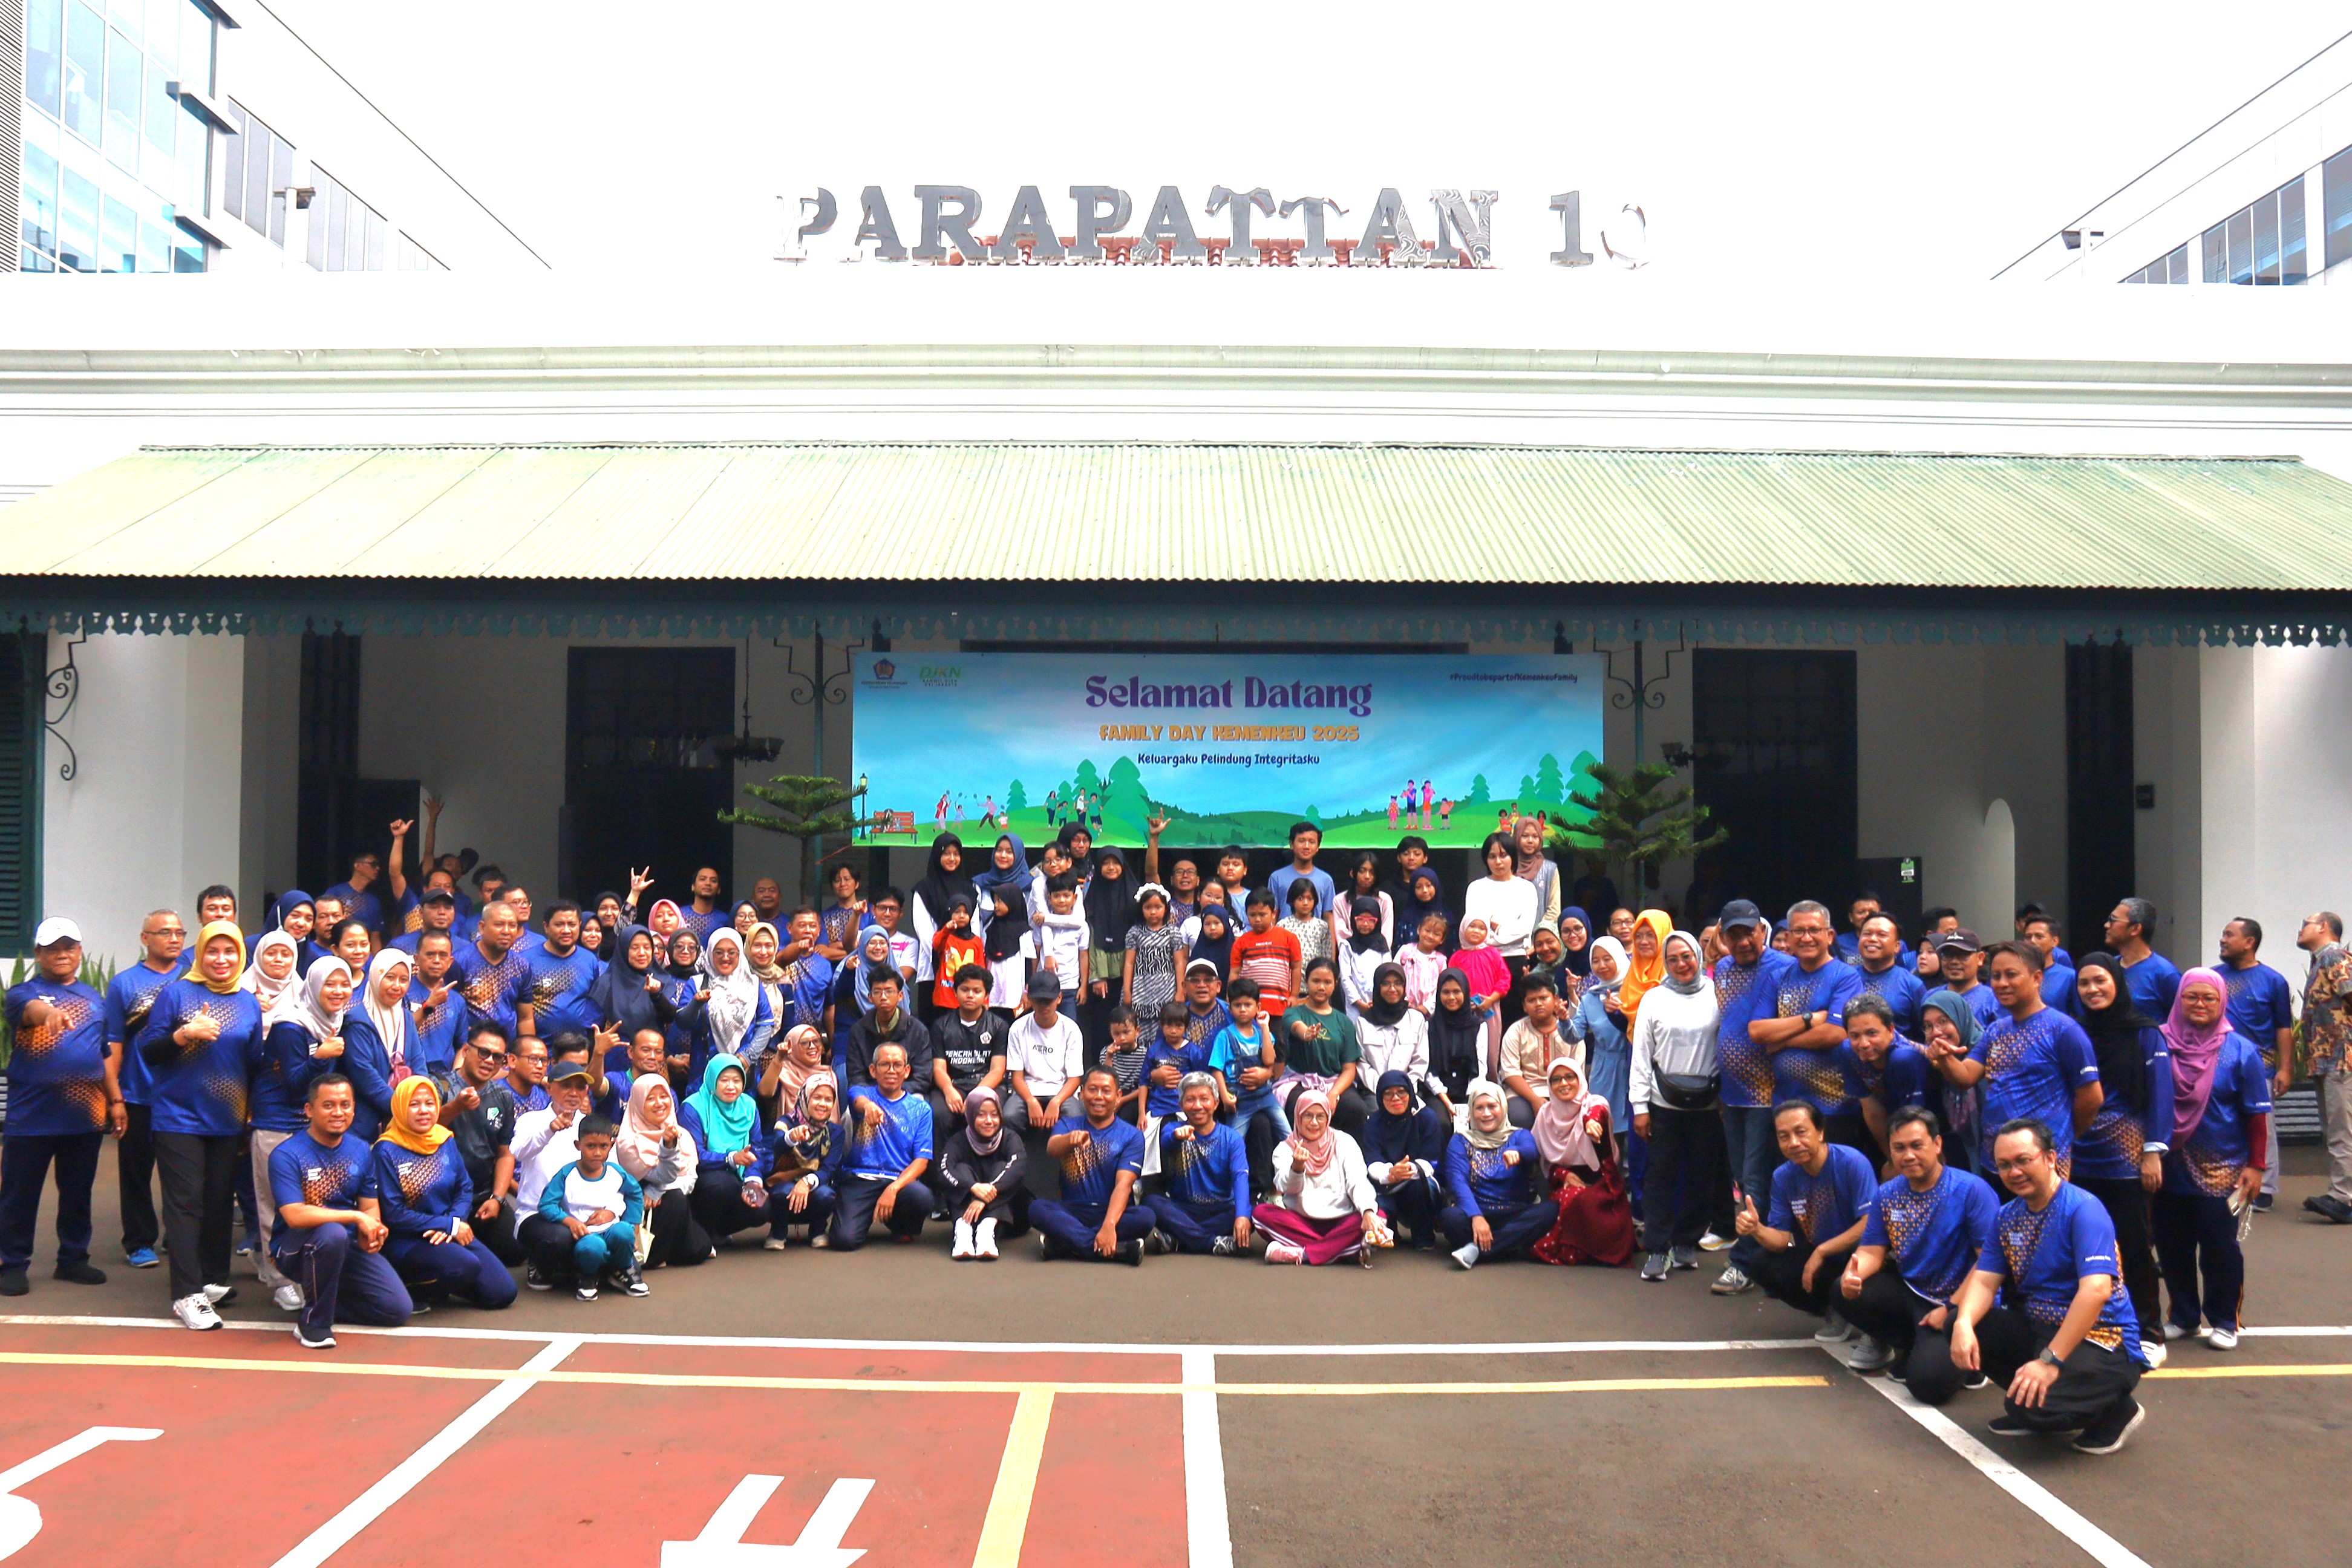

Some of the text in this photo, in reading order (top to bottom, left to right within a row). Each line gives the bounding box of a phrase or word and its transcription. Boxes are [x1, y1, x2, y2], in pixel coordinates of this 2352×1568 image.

[773, 185, 1499, 269] PARAPATTAN
[920, 666, 962, 678] DJKN
[1085, 675, 1373, 717] Selamat Datang
[1099, 724, 1360, 741] FAMILY DAY KEMENKEU 2025
[1137, 753, 1320, 767] Keluargaku Pelindung Integritasku
